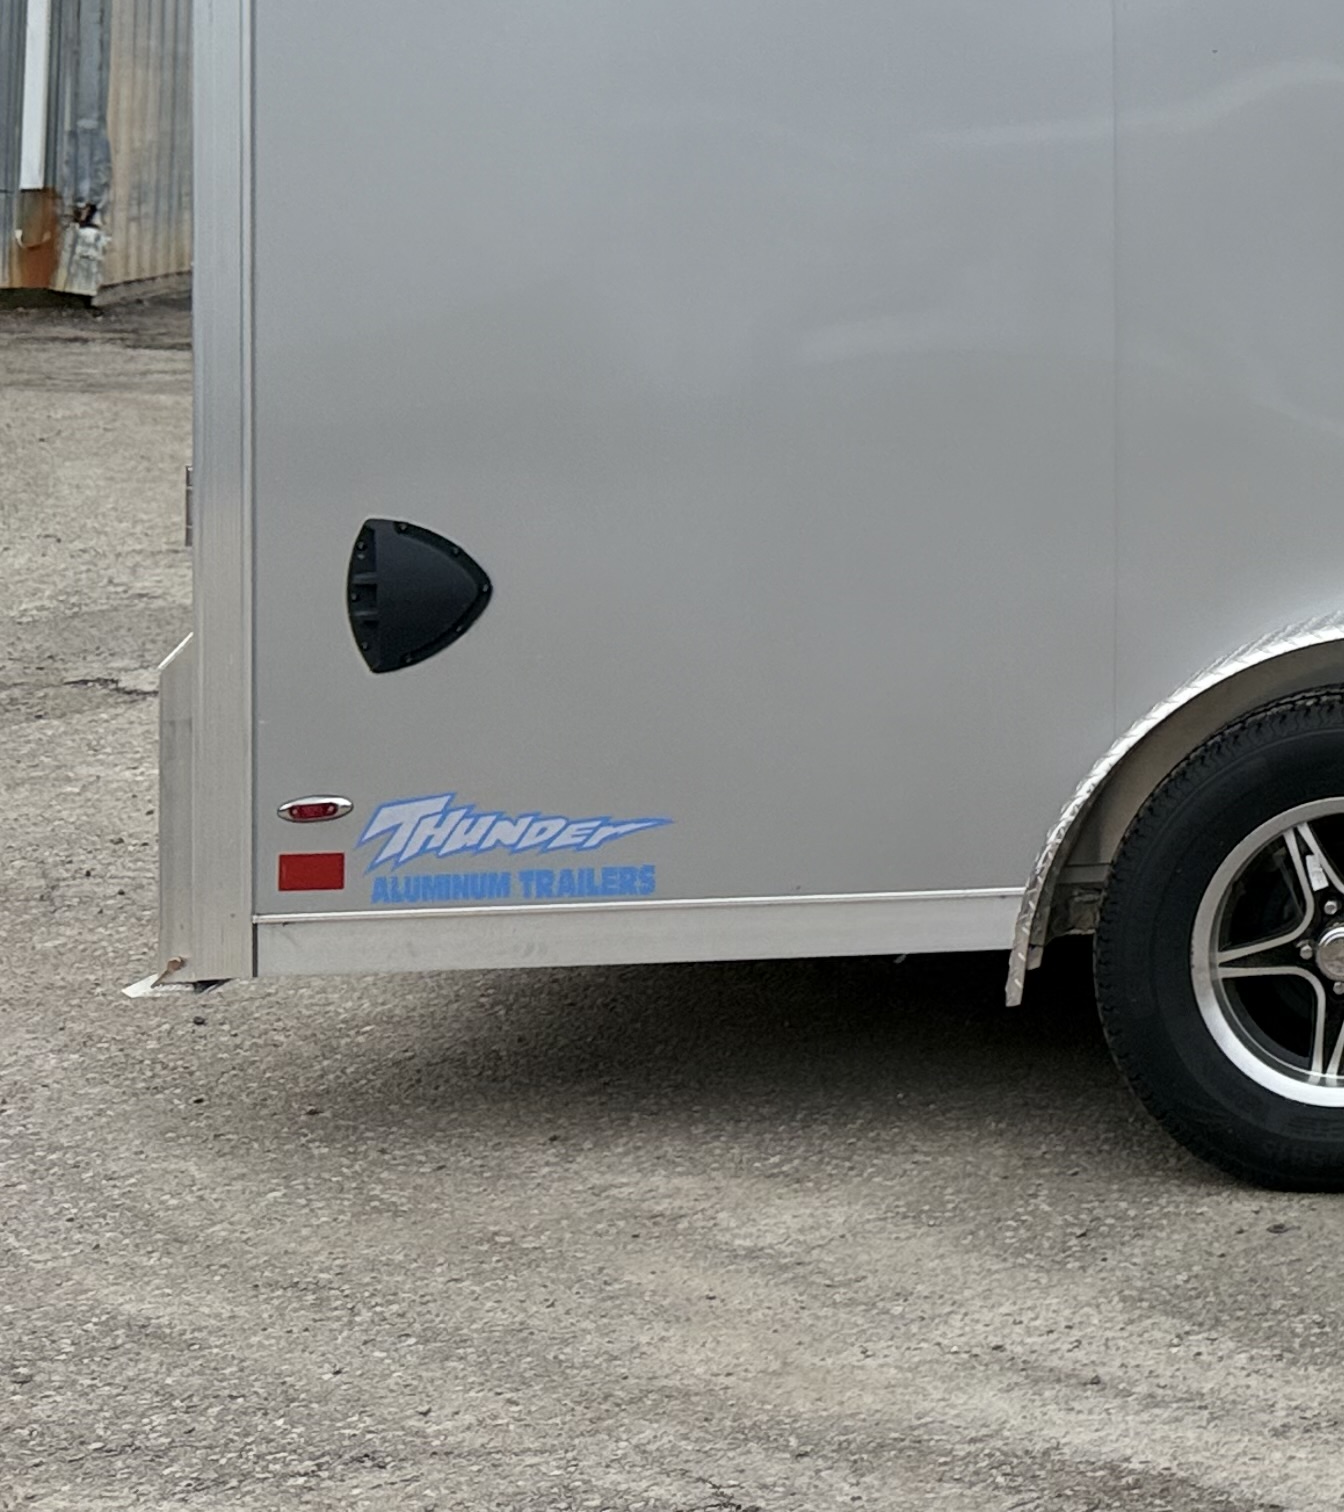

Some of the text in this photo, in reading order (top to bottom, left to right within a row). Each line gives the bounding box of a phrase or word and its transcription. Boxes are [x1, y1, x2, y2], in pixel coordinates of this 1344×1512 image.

[355, 792, 675, 875] THUNDER
[371, 864, 656, 904] ALUMINUM TRAILERS
